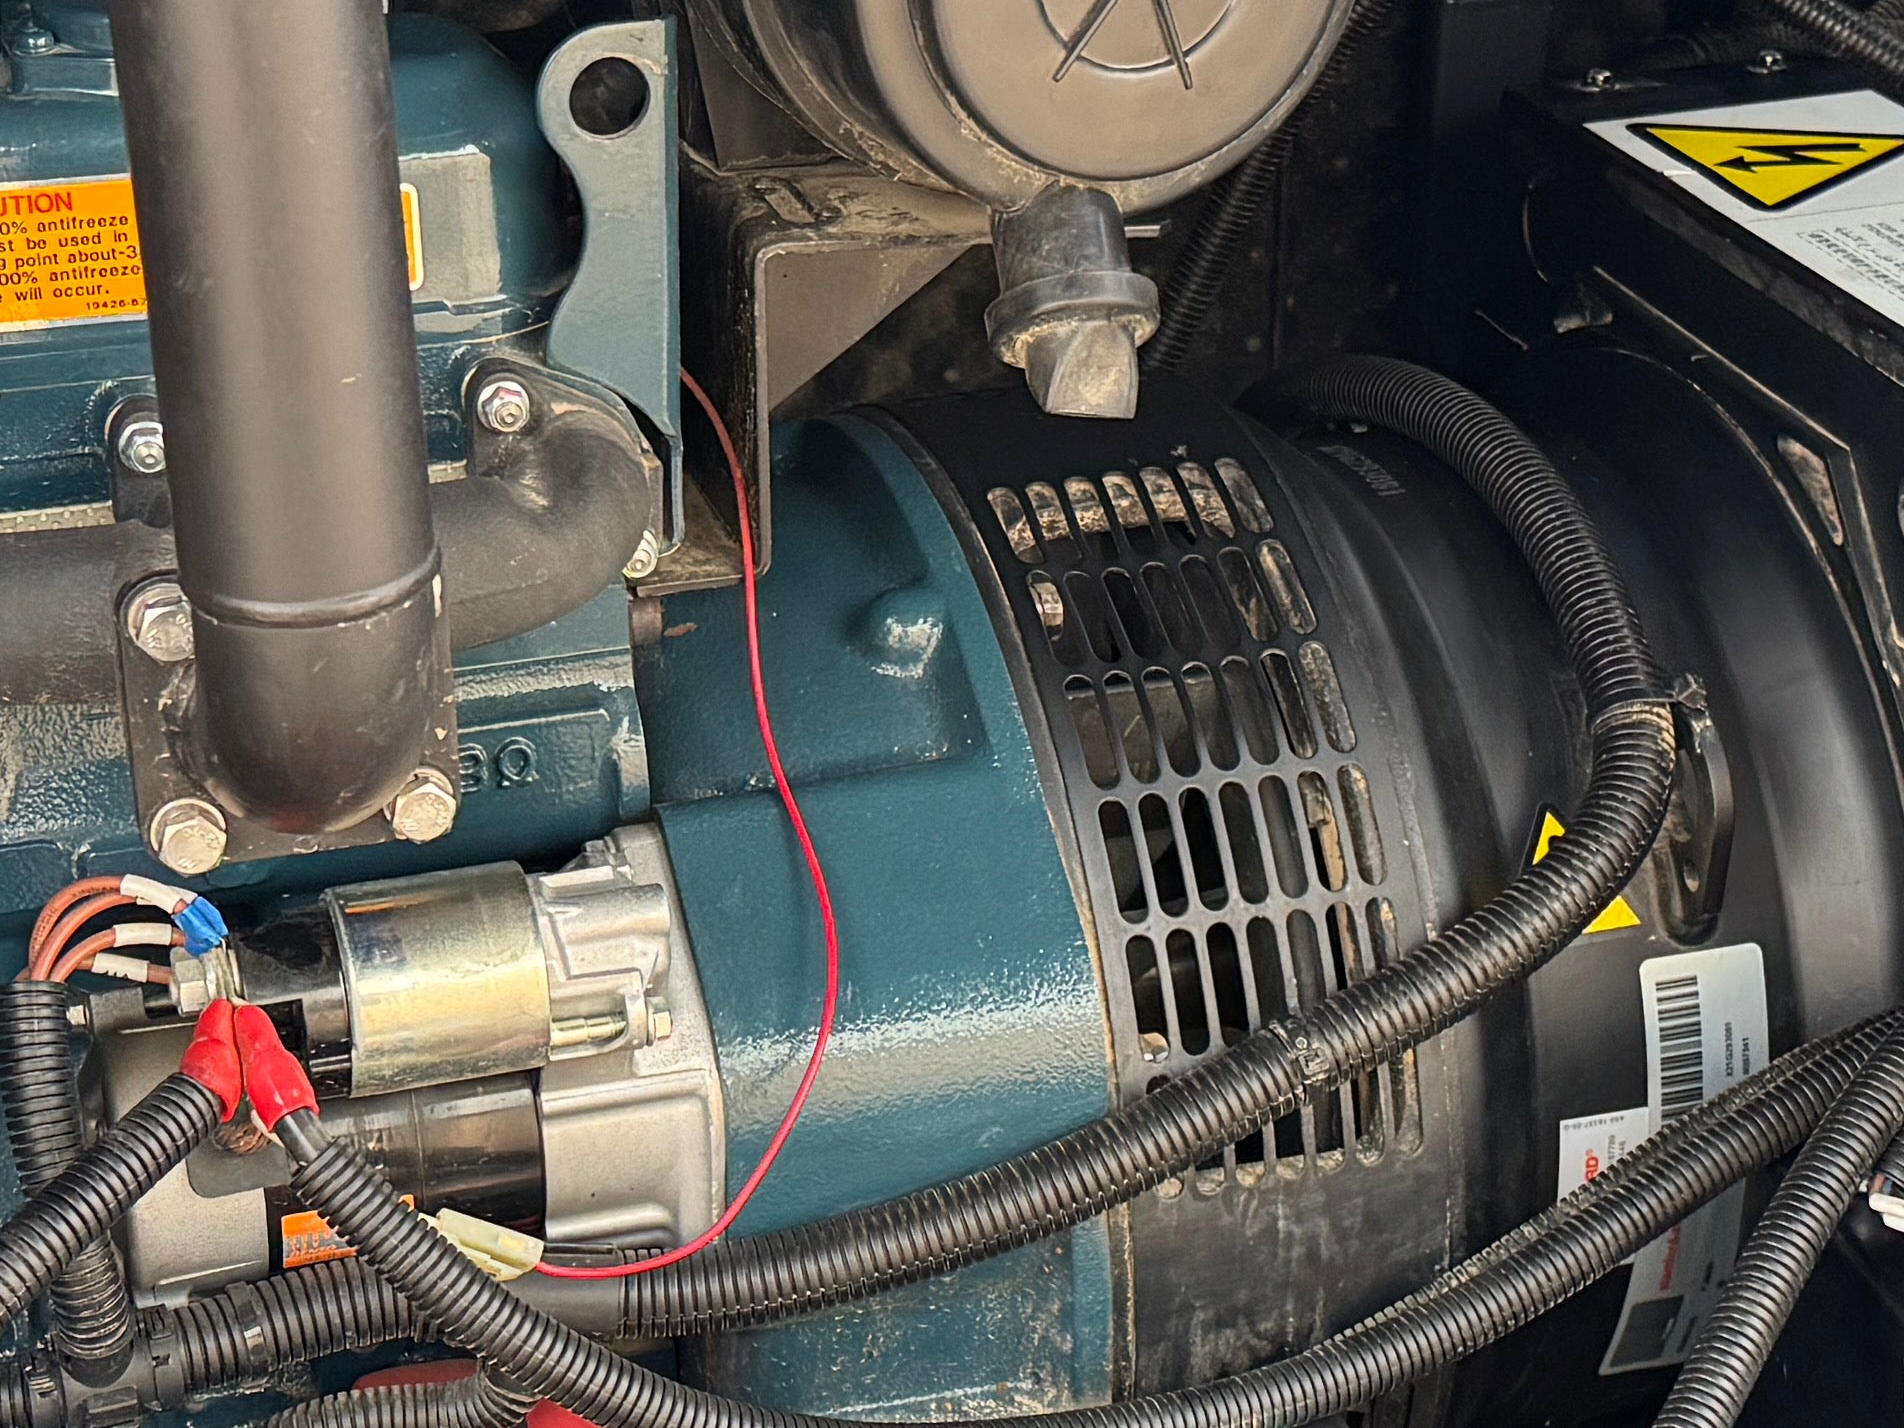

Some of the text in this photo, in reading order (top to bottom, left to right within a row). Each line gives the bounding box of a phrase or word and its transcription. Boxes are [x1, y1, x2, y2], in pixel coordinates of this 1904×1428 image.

[37, 215, 129, 232] antifreeze
[26, 237, 47, 250] be
[58, 232, 102, 248] used
[113, 230, 128, 243] in
[15, 253, 59, 270] point
[68, 245, 139, 264] about-3
[14, 287, 42, 302] will
[53, 284, 110, 298] occur.
